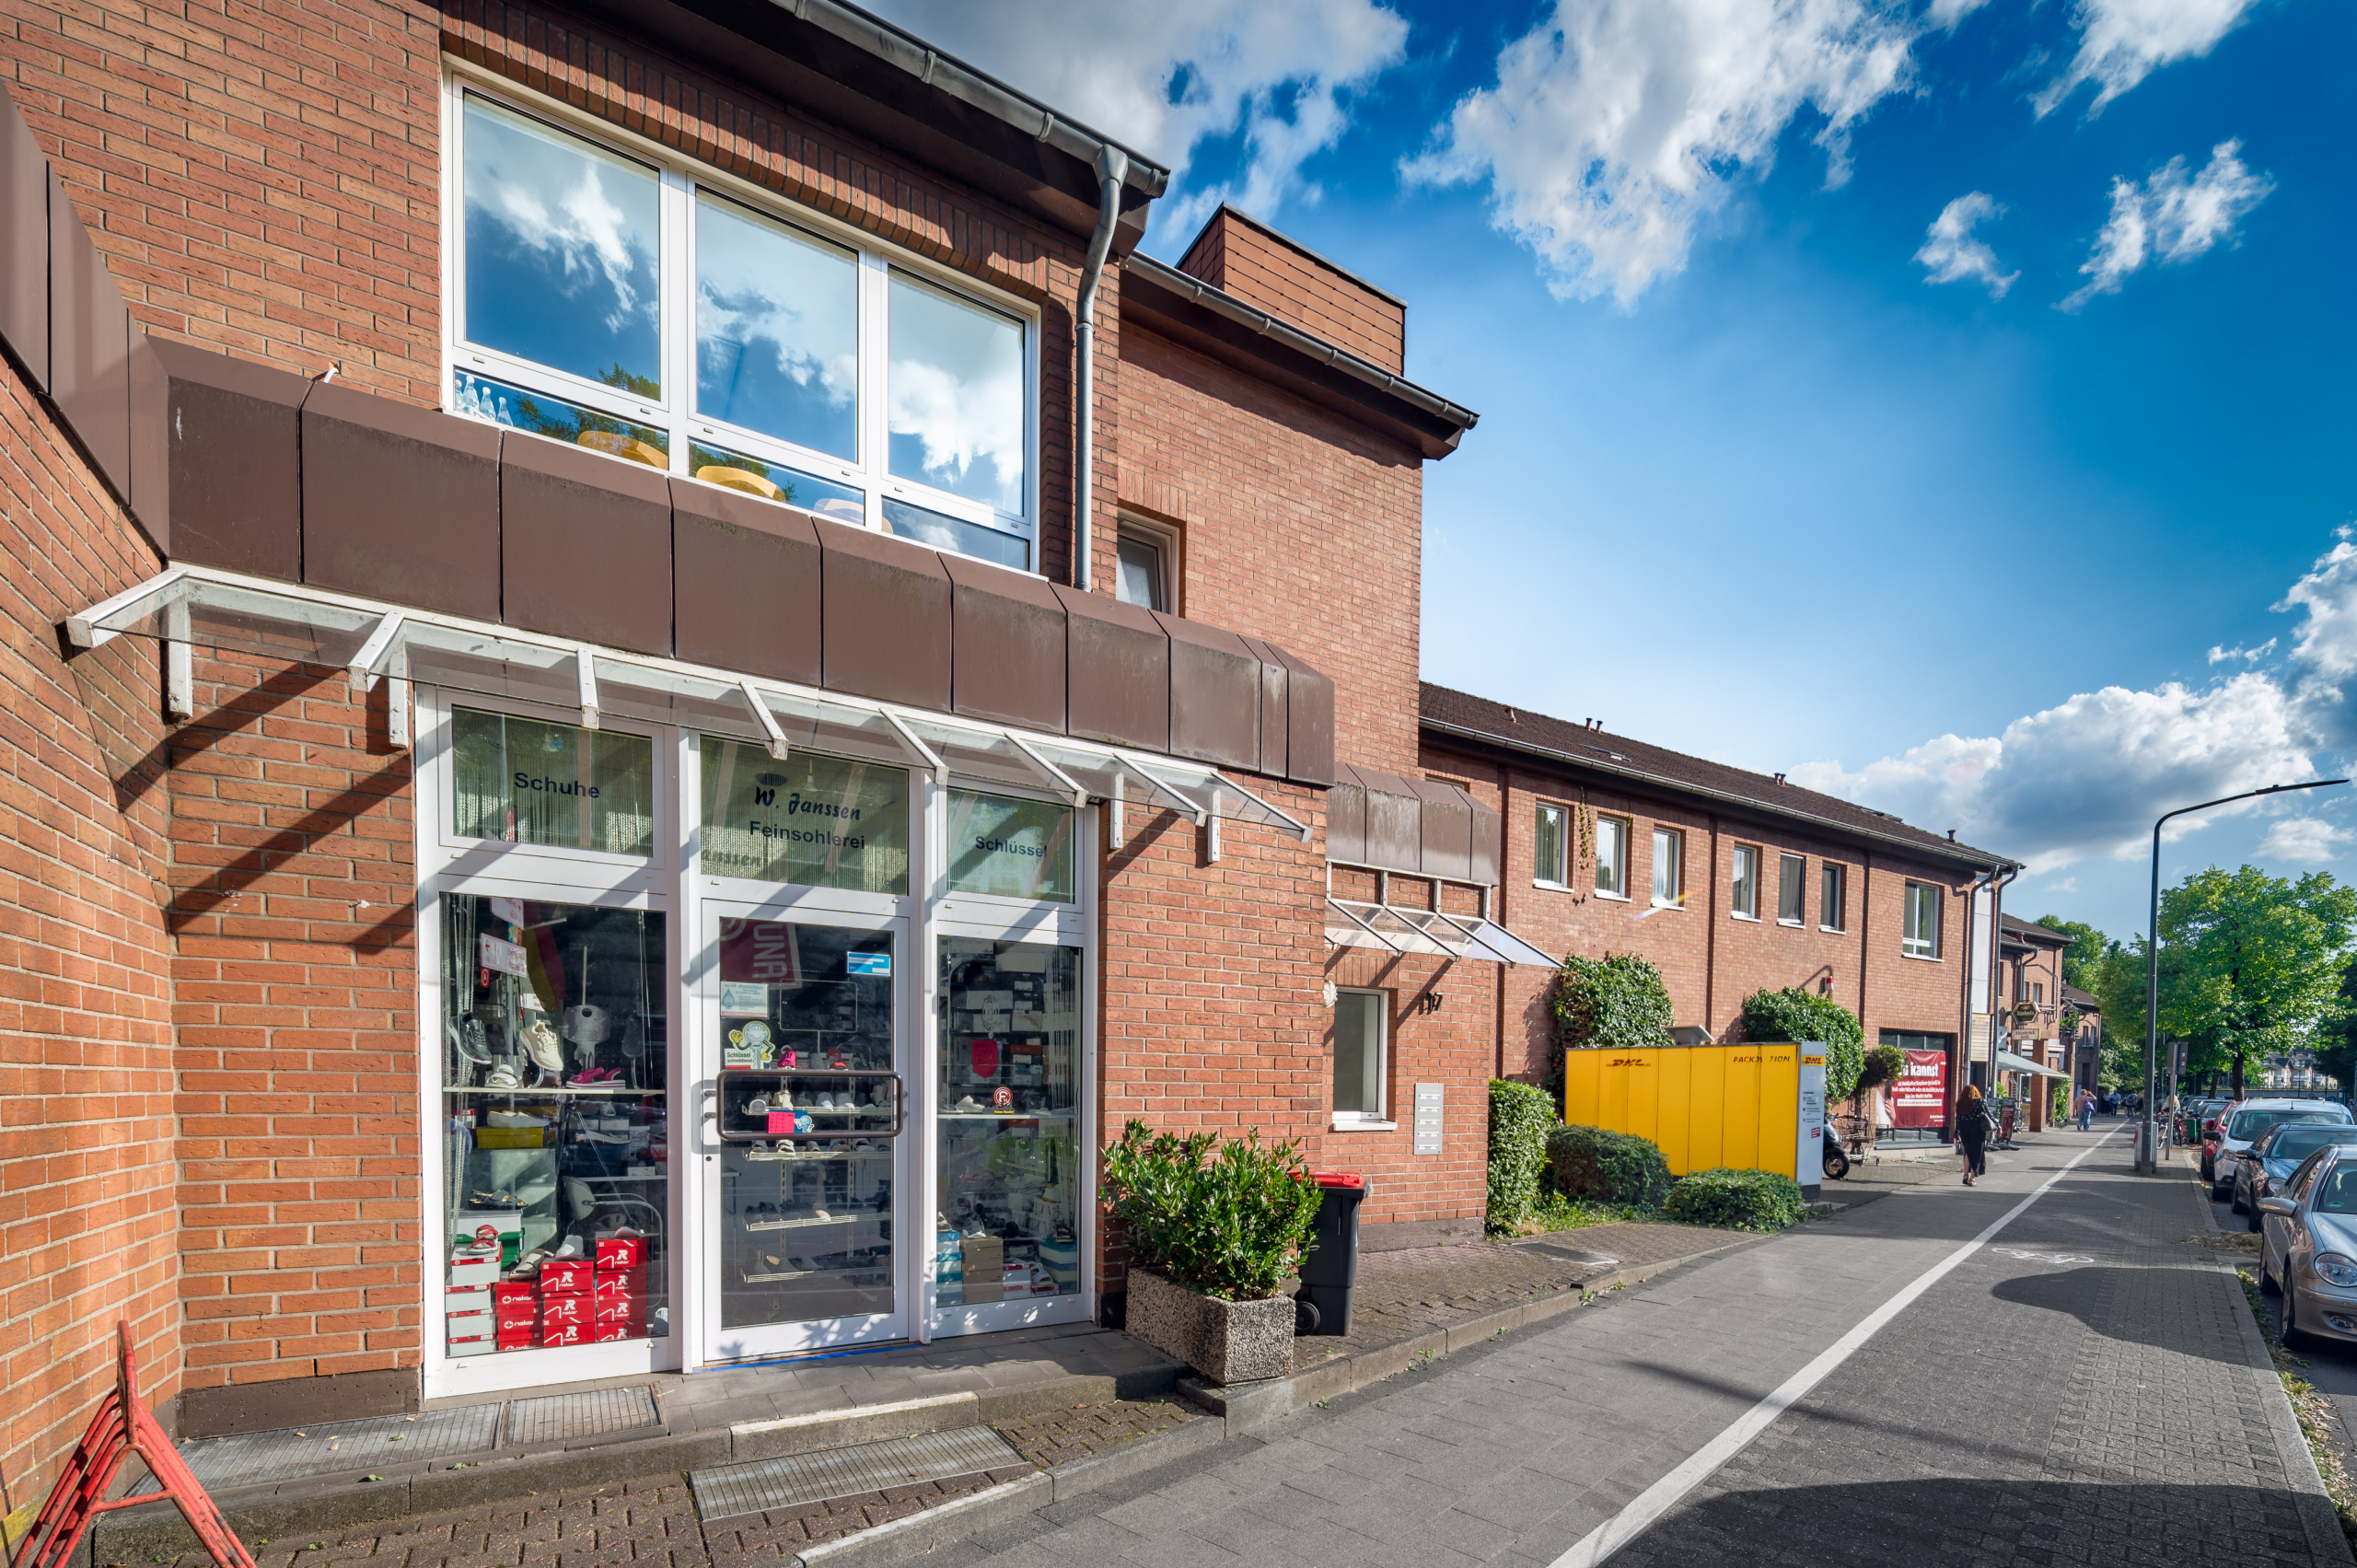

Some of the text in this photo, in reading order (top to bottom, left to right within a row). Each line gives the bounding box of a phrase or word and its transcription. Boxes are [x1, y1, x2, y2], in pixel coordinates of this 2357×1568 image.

[515, 772, 600, 798] Schuhe
[755, 785, 861, 821] W. Janssen
[749, 820, 865, 849] Feinsohlerei
[976, 836, 1047, 857] Schlüssel
[1426, 992, 1443, 1015] 17
[1611, 1059, 1645, 1067] DHL
[1910, 1061, 1939, 1077] kannst
